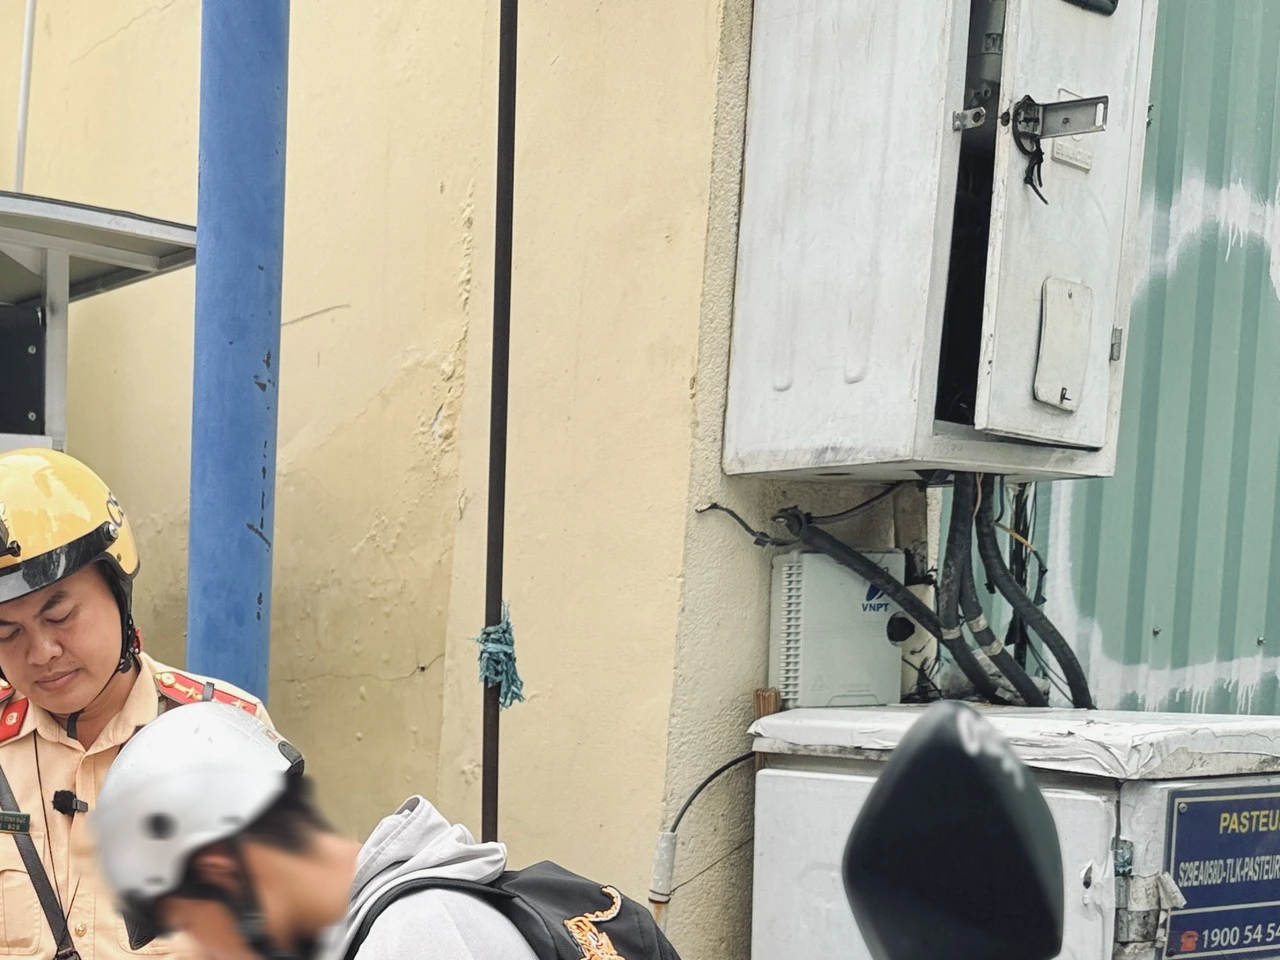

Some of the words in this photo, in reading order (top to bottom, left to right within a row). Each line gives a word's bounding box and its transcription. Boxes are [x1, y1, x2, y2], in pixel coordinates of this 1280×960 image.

[862, 603, 889, 612] VNPT
[1219, 809, 1280, 834] PASTEU
[1202, 926, 1240, 948] 1900
[1243, 924, 1262, 944] 54
